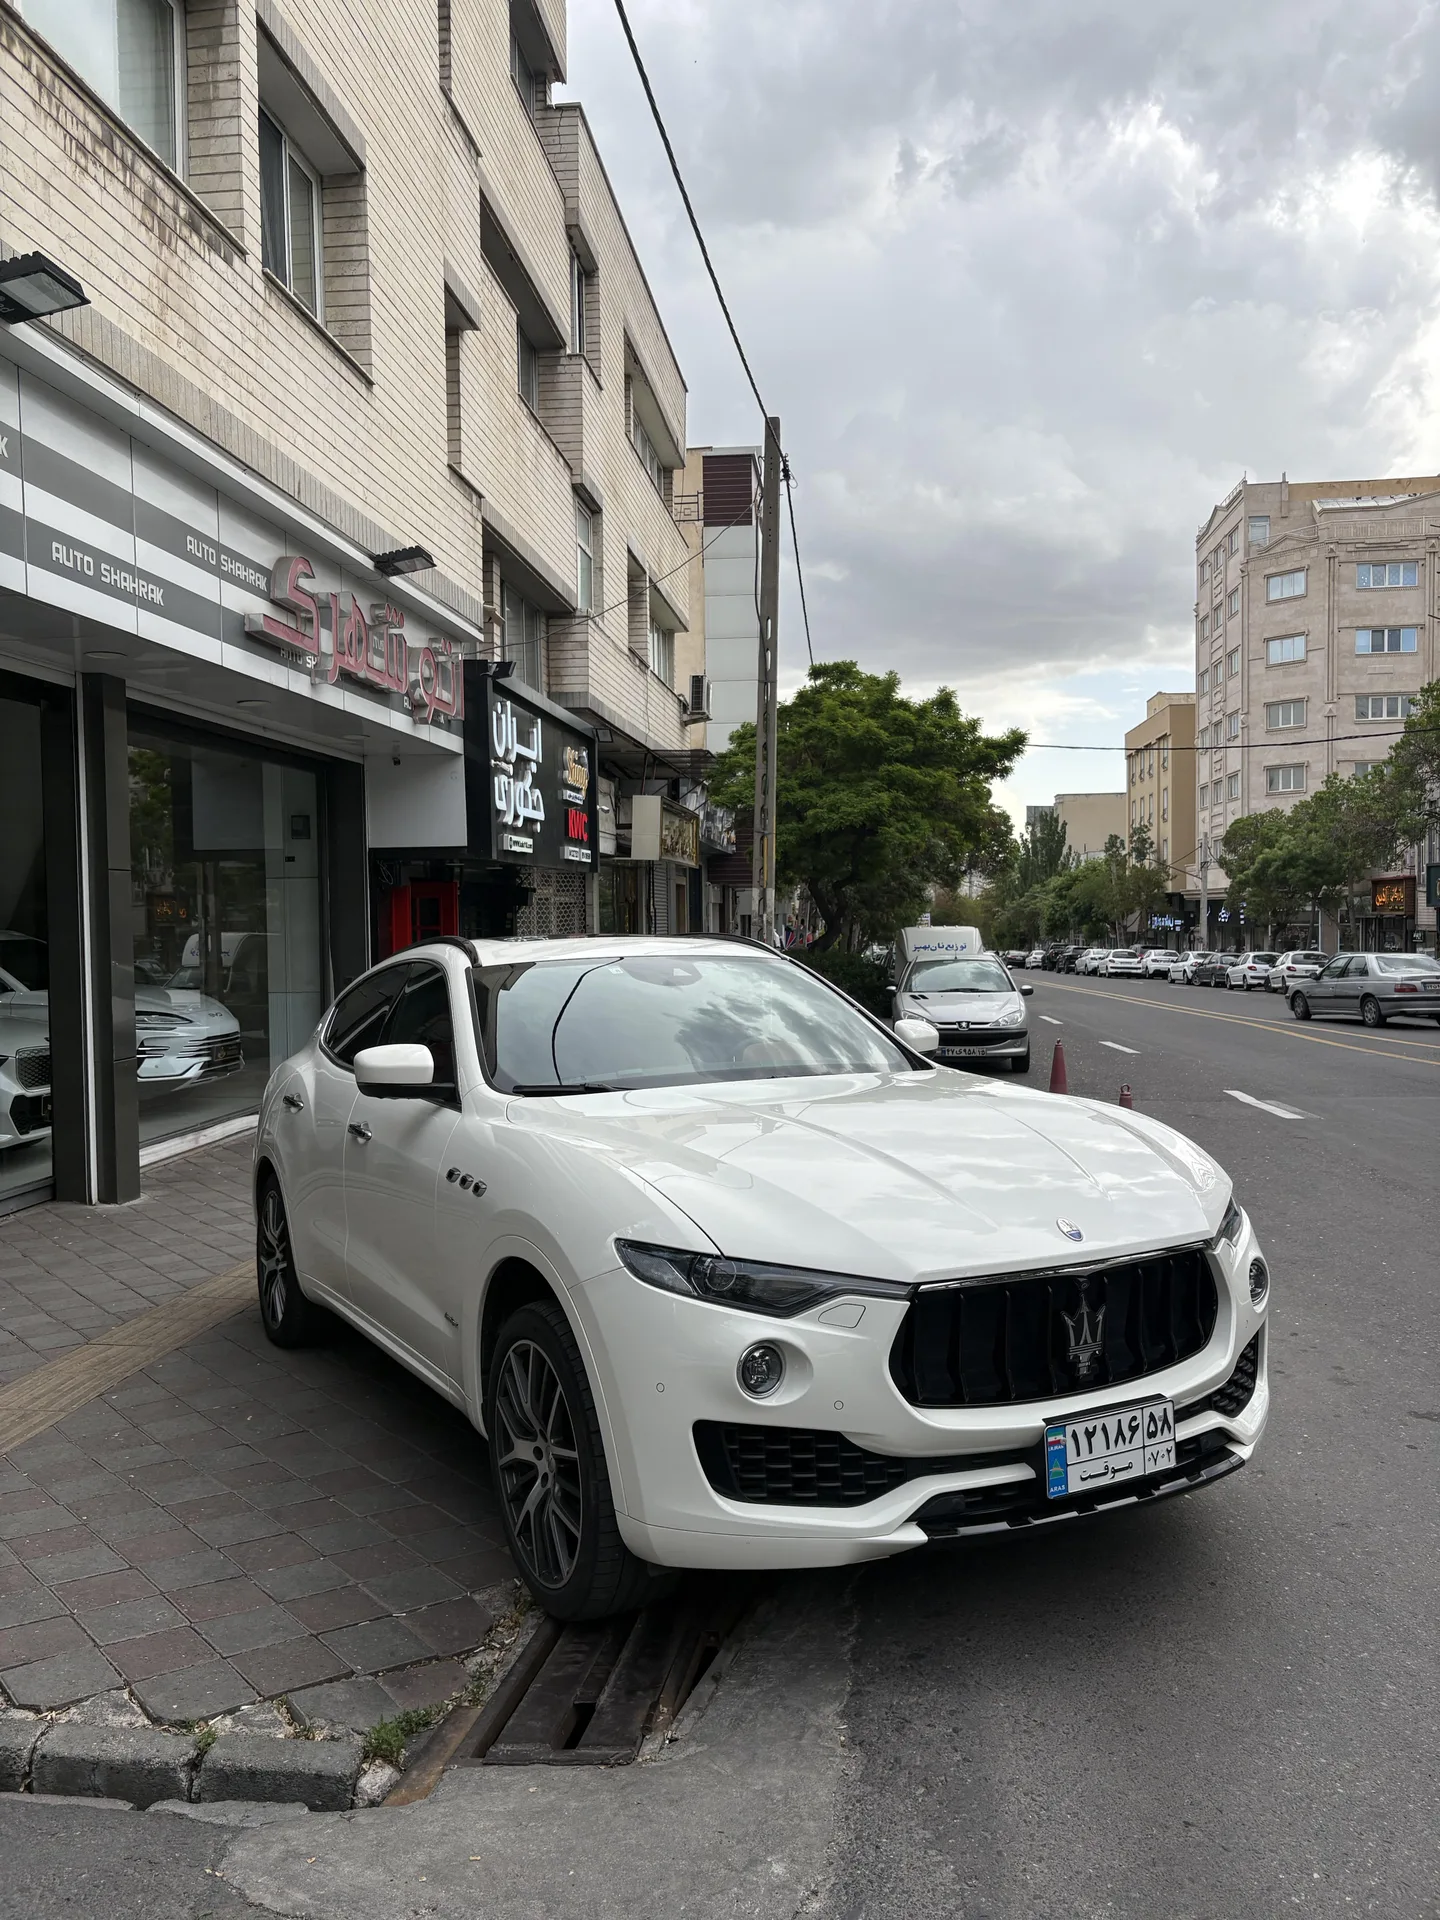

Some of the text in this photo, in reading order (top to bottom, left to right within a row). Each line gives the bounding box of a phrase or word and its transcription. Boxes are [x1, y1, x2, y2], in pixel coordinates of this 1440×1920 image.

[51, 541, 164, 606] AUTO SHAHRAK
[187, 535, 268, 592] AUTO SHAHRAK
[492, 701, 542, 770] ایران
[568, 808, 588, 842] KWC
[930, 942, 945, 951] نان
[945, 942, 967, 951] توزیع
[1079, 1459, 1133, 1482] موقت
[1050, 1485, 1066, 1493] ARAS
